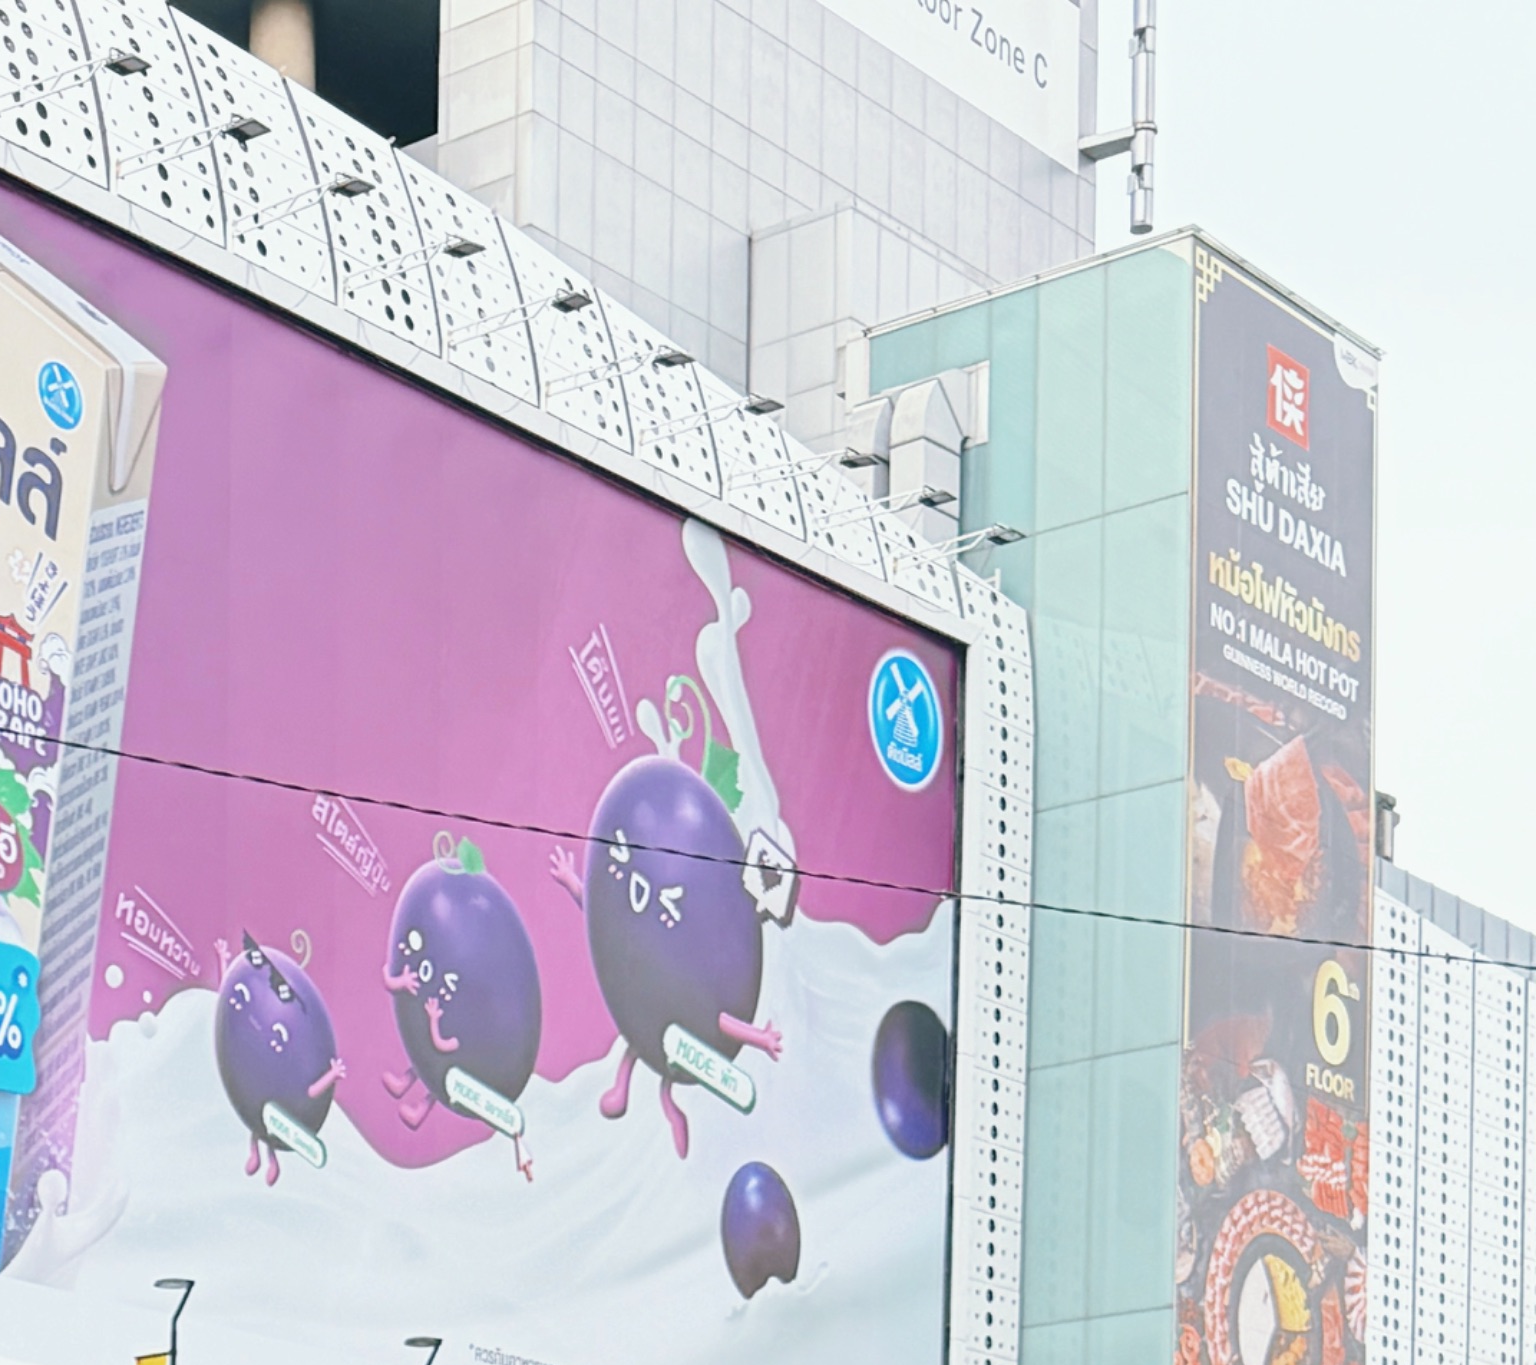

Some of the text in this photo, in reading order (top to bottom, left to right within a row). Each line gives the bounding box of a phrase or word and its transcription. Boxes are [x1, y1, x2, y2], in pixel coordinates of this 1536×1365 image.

[970, 8, 1025, 74] Zone
[1034, 53, 1048, 89] C
[1226, 478, 1346, 577] SHU DAXIA
[1209, 548, 1360, 662] หม้อไฟหัวมังกร
[1223, 644, 1346, 720] GUINNESS WORLD RECORD
[1250, 624, 1293, 670] MALA
[1296, 649, 1327, 686] HOT
[1329, 667, 1359, 702] POT
[676, 1037, 716, 1080] MODE
[1306, 1063, 1355, 1102] FLOOR
